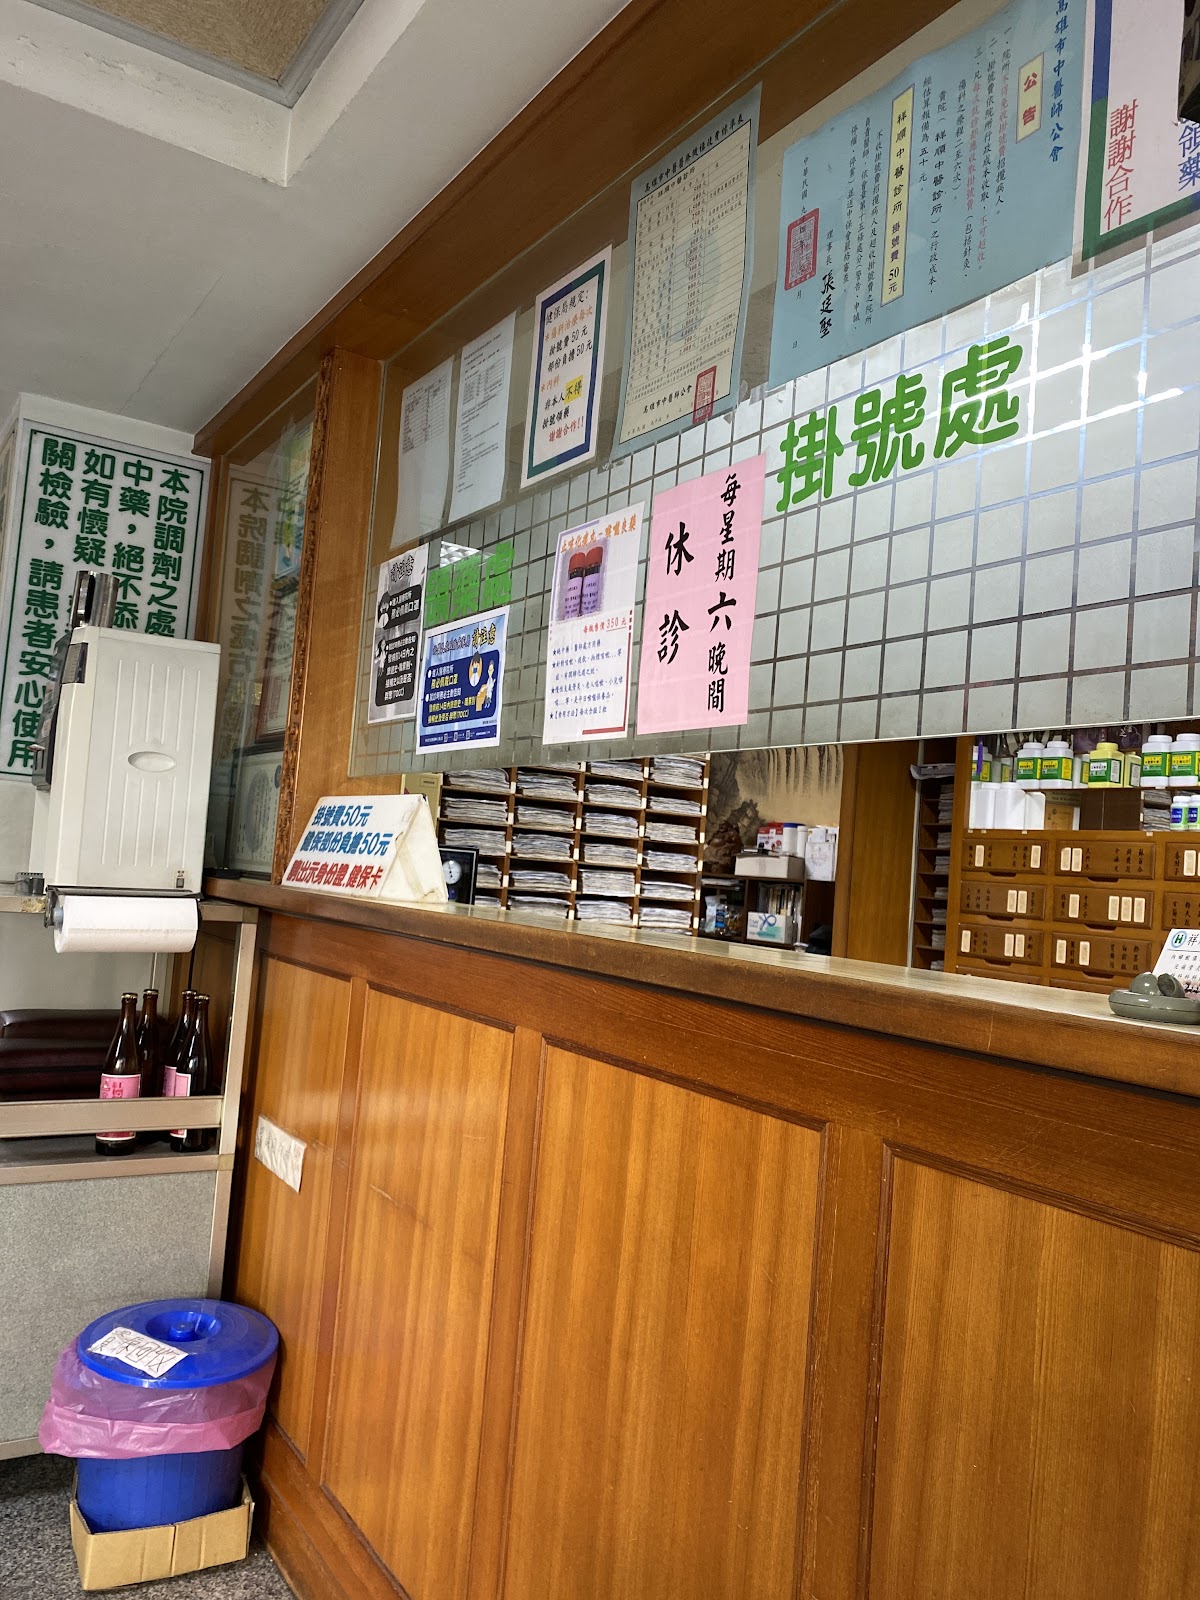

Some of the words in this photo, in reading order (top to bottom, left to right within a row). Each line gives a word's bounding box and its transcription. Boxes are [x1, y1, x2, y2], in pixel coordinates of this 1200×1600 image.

[1022, 72, 1038, 125] 公告
[1178, 117, 1200, 191] 領藥
[1103, 99, 1139, 231] 謝謝合作
[776, 335, 1024, 513] 掛號處
[657, 522, 695, 665] 休診
[707, 474, 742, 713] 每星期六晚間
[311, 805, 374, 828] 掛號費50元
